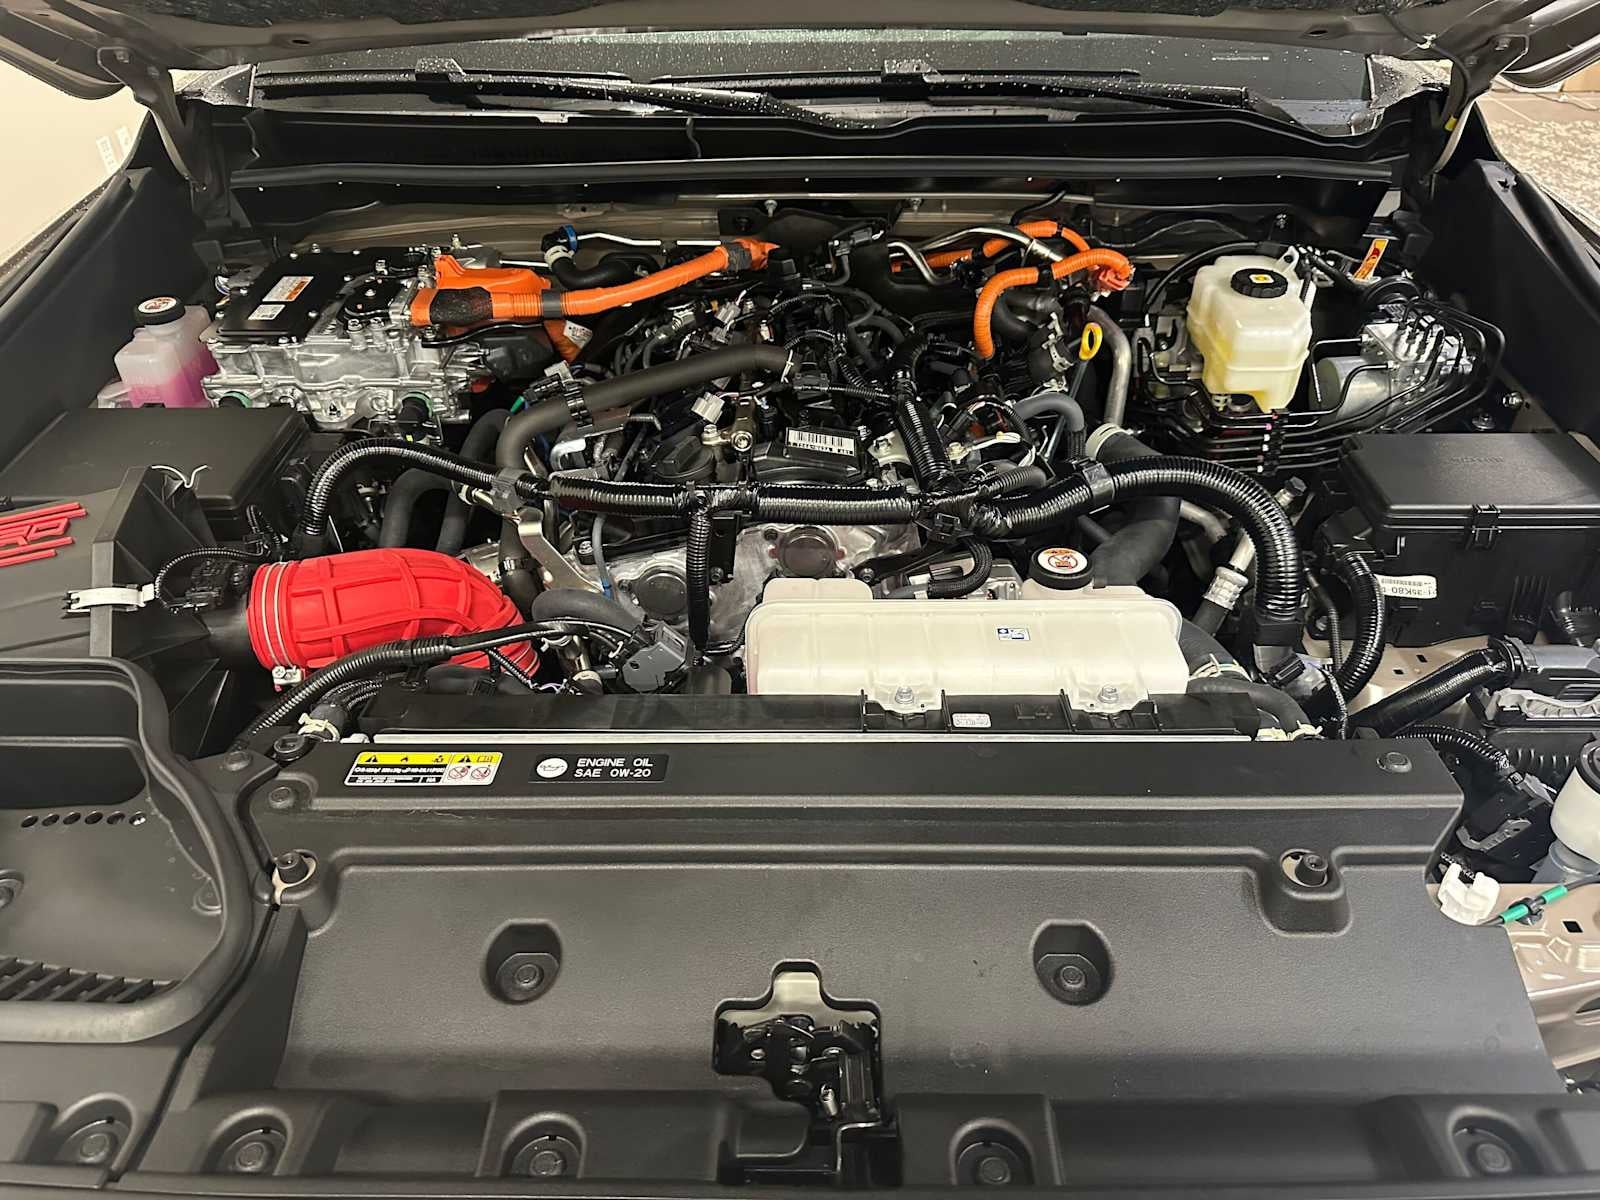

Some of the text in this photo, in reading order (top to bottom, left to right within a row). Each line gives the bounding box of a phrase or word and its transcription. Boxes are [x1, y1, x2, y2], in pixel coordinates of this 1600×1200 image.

[577, 758, 654, 767] ENGINE OIL
[573, 768, 652, 778] SAE 0W-20
